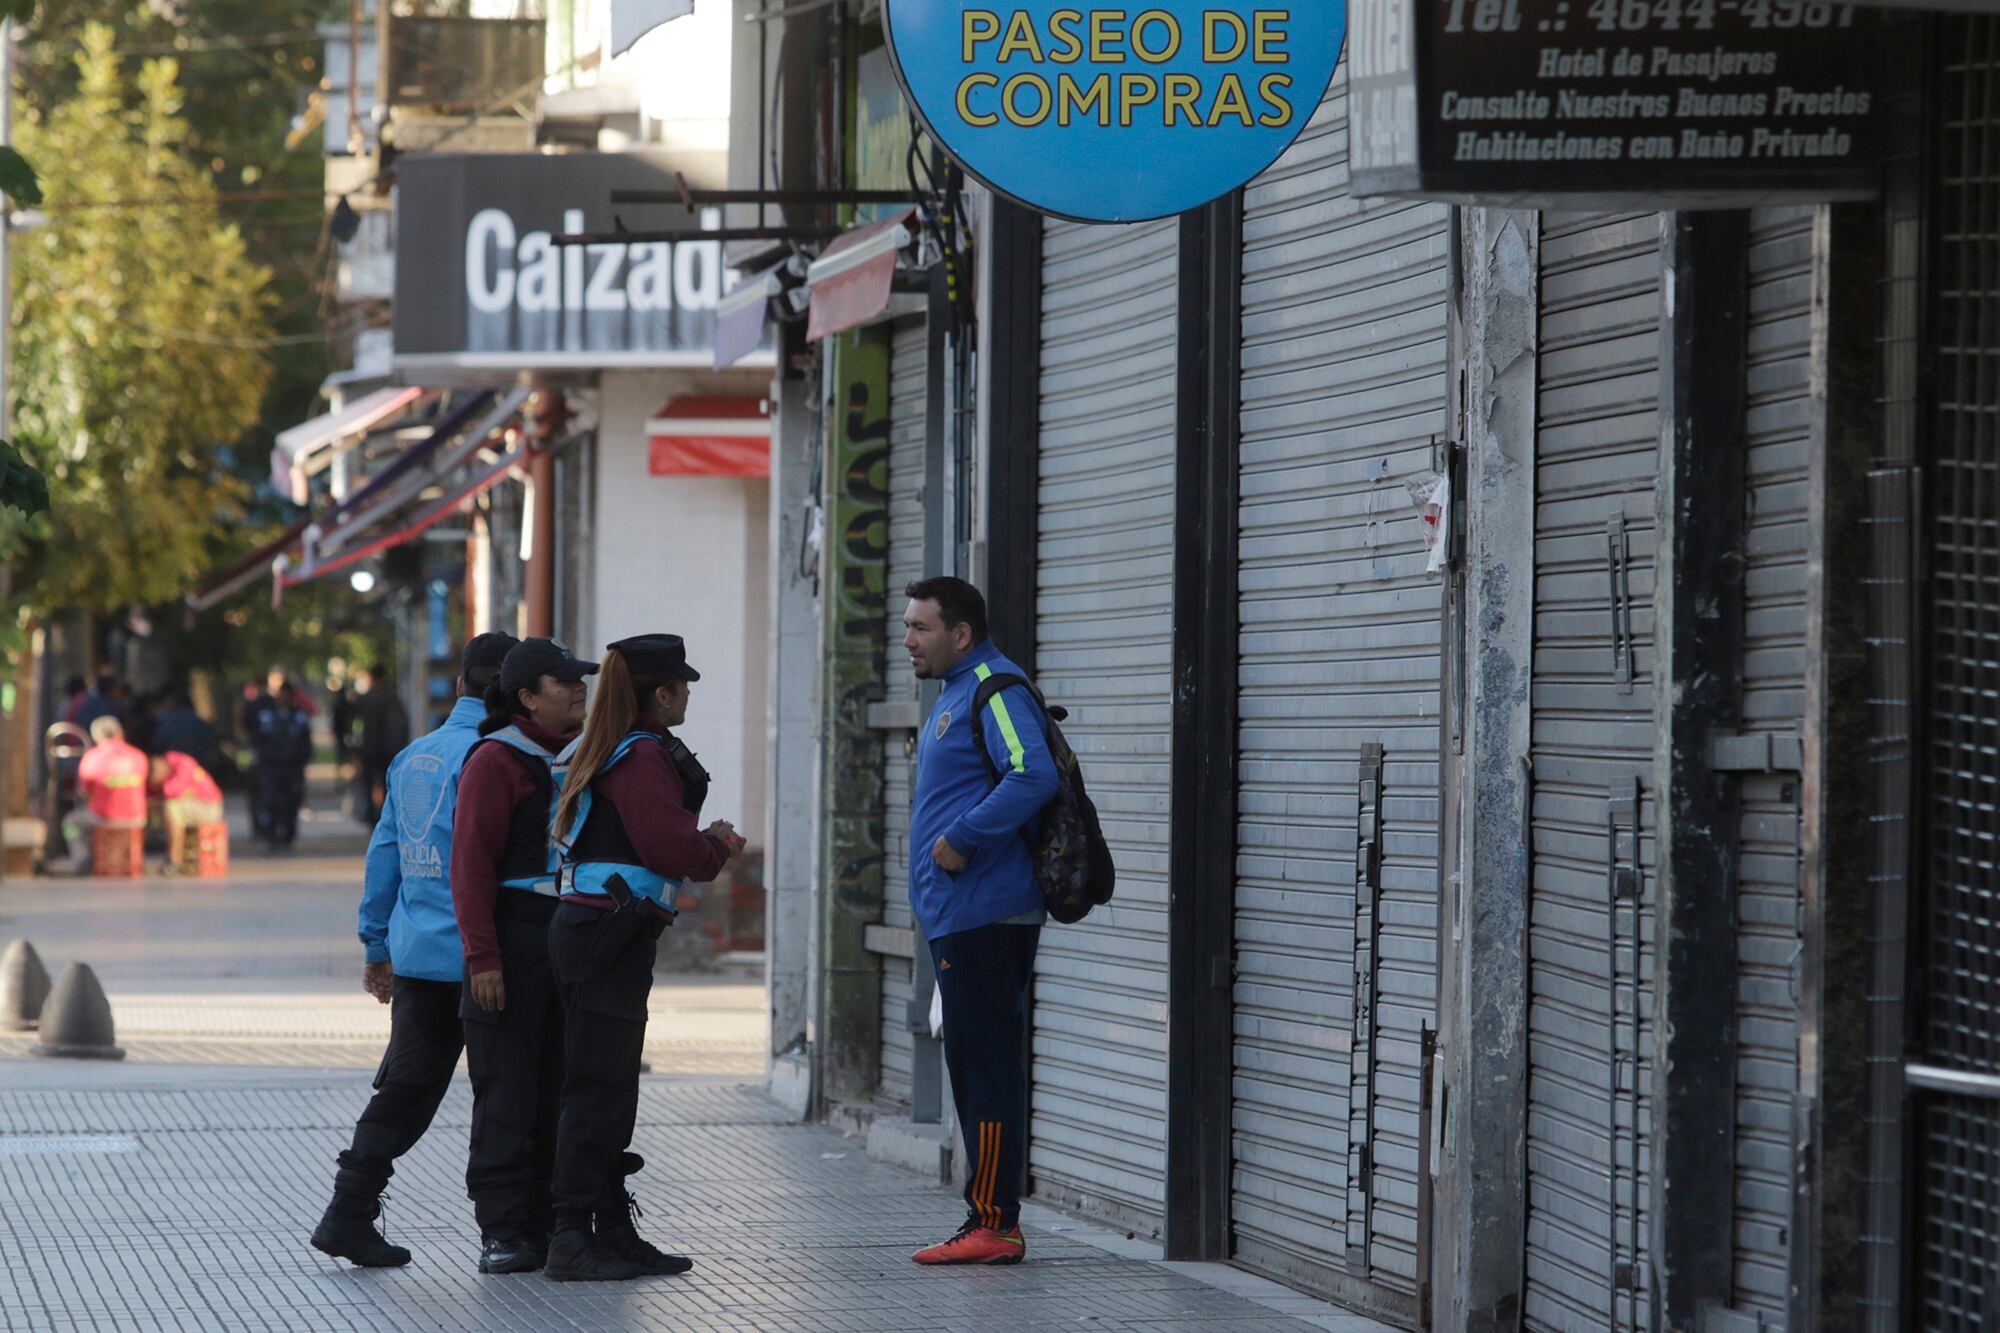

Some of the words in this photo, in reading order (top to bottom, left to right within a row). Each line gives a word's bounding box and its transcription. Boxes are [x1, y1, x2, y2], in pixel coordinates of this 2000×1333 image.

[1443, 0, 1520, 32] Tel
[962, 10, 1181, 63] PASEO
[1202, 11, 1289, 63] DE
[1538, 48, 1604, 78] Hotel
[1612, 48, 1641, 76] de
[1650, 48, 1776, 82] Pasajeros
[955, 73, 1294, 127] COMPRAS
[1441, 90, 1549, 121] Consulte
[1555, 89, 1670, 119] Nuestros
[1676, 87, 1766, 117] Buenos
[1773, 85, 1870, 116] Precios
[1454, 131, 1621, 161] Habitaciones
[1629, 133, 1674, 159] con
[1679, 129, 1742, 159] Baño
[1749, 128, 1851, 157] Privado
[465, 208, 741, 313] Calzad
